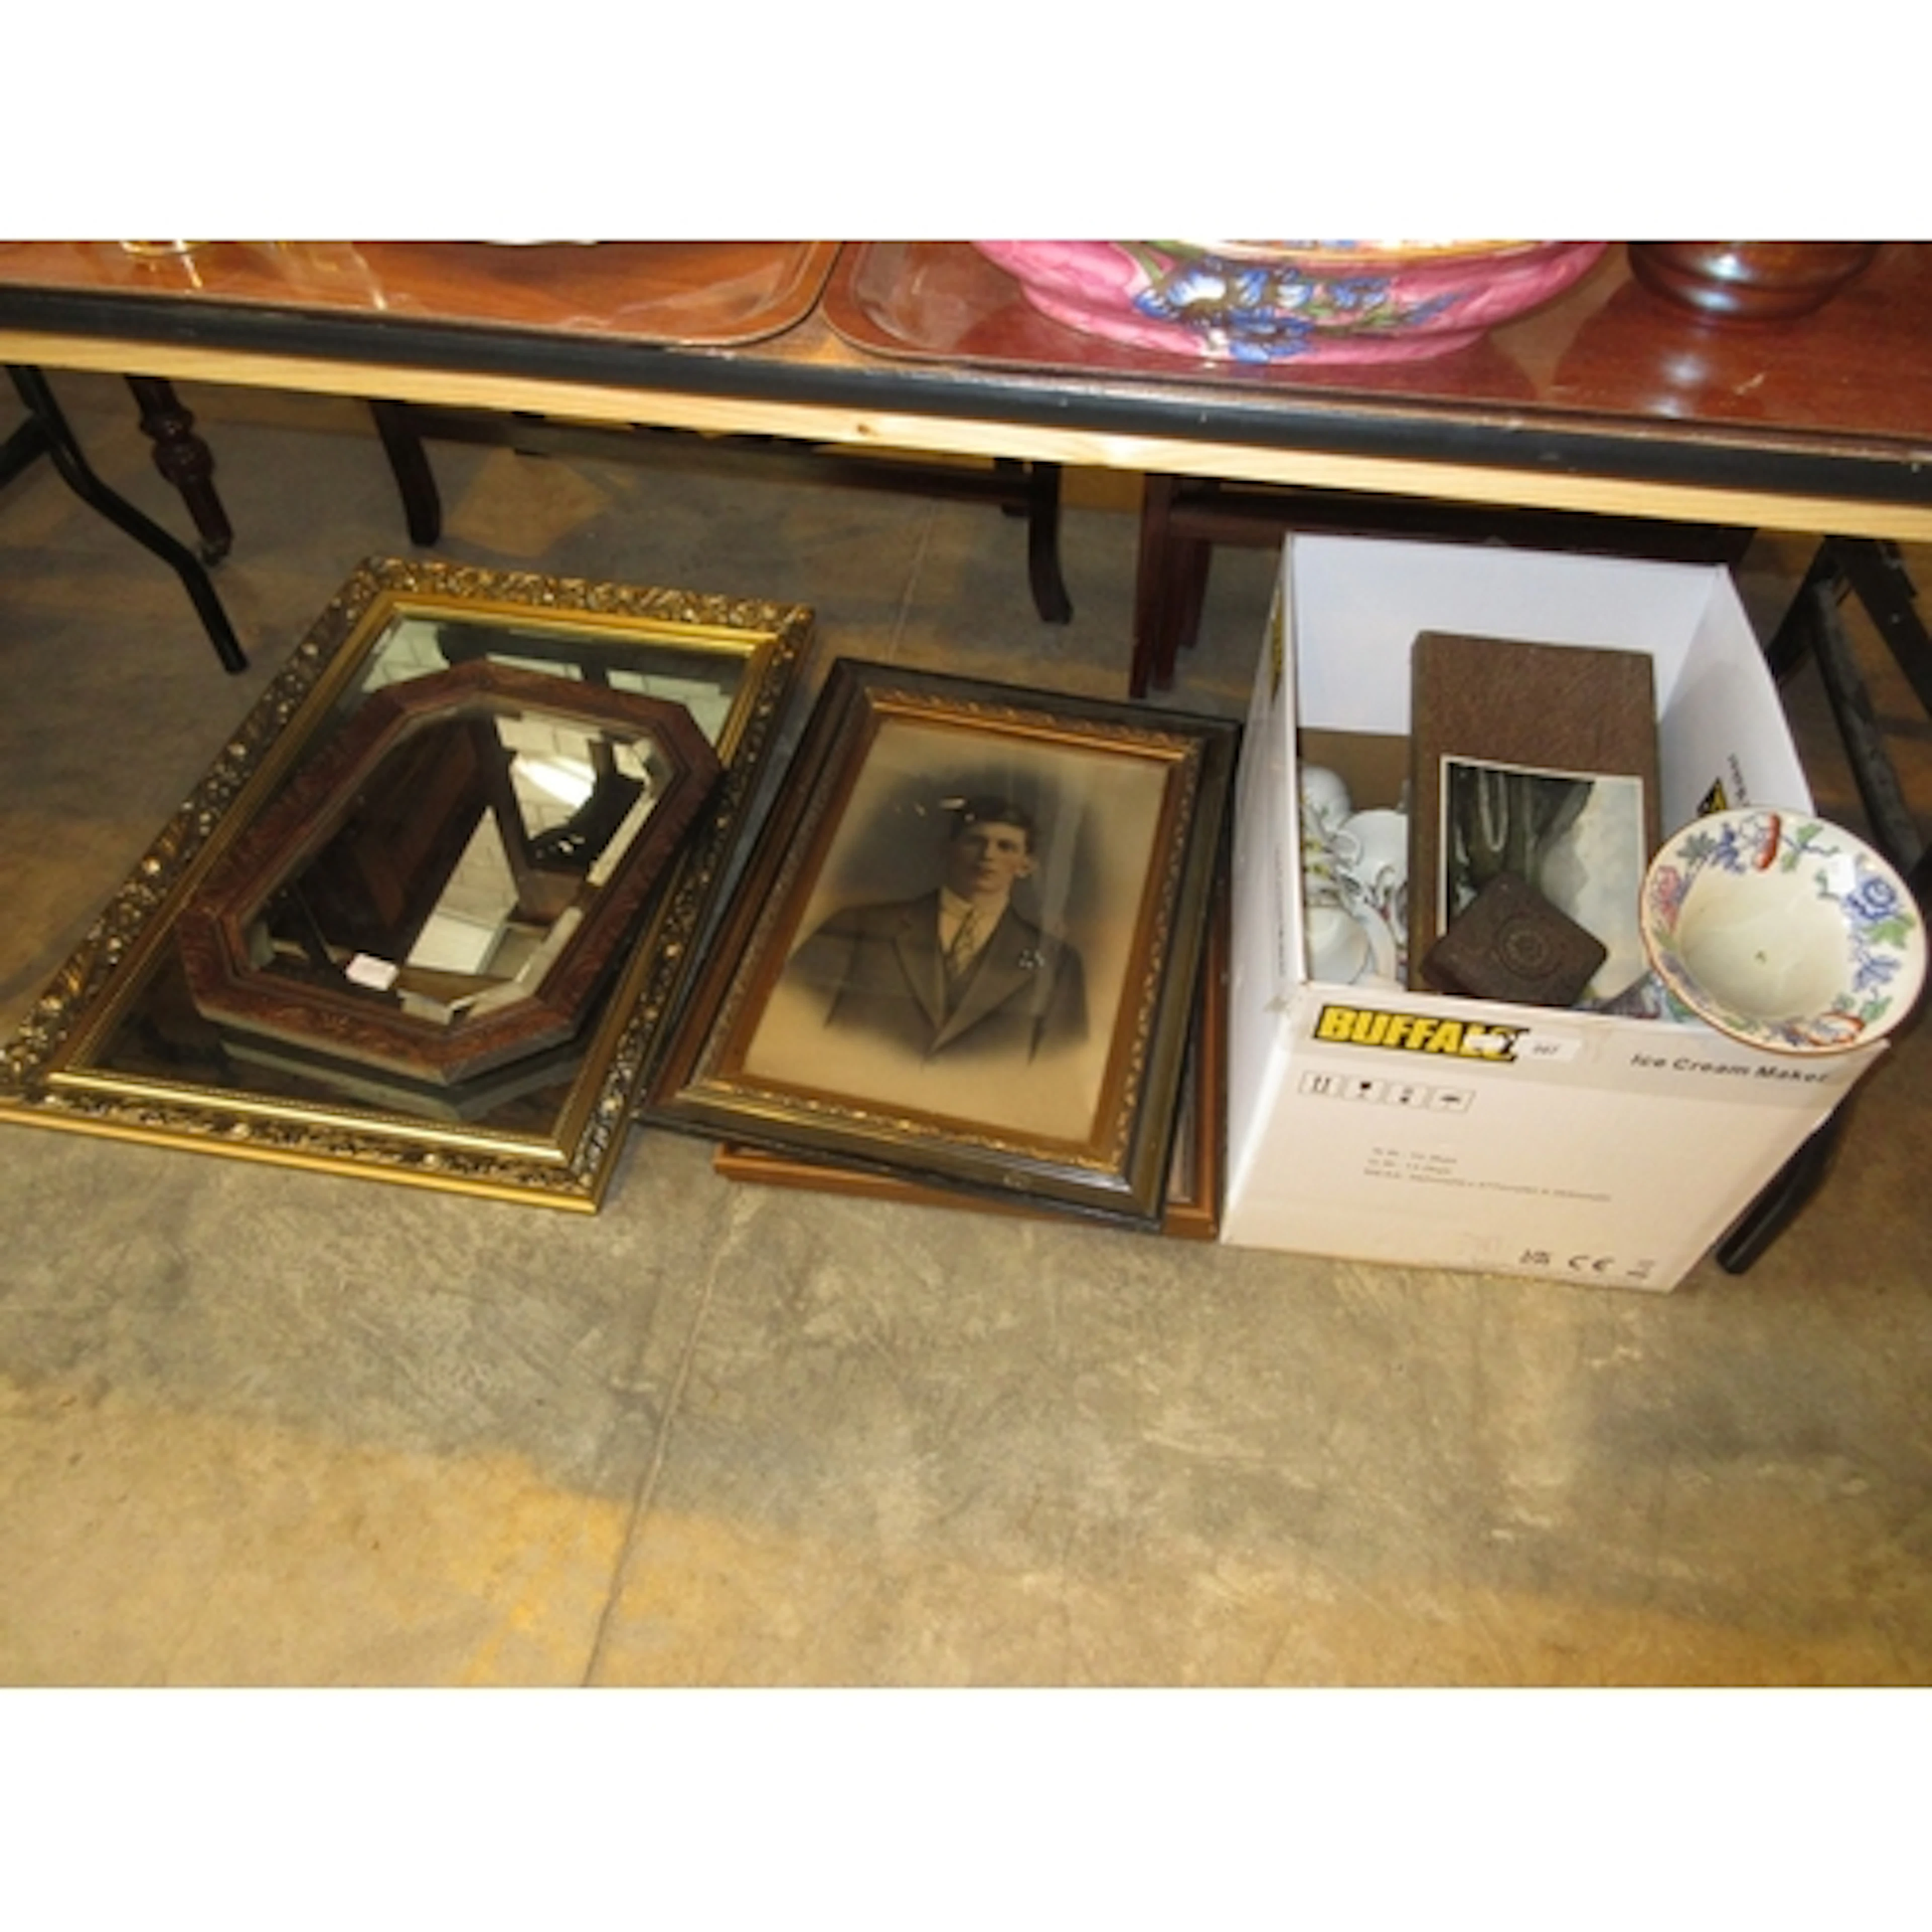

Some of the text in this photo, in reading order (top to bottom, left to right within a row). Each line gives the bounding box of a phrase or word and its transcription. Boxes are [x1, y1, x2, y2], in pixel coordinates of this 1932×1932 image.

[1630, 1054, 1829, 1083] Ice Cream Maker
